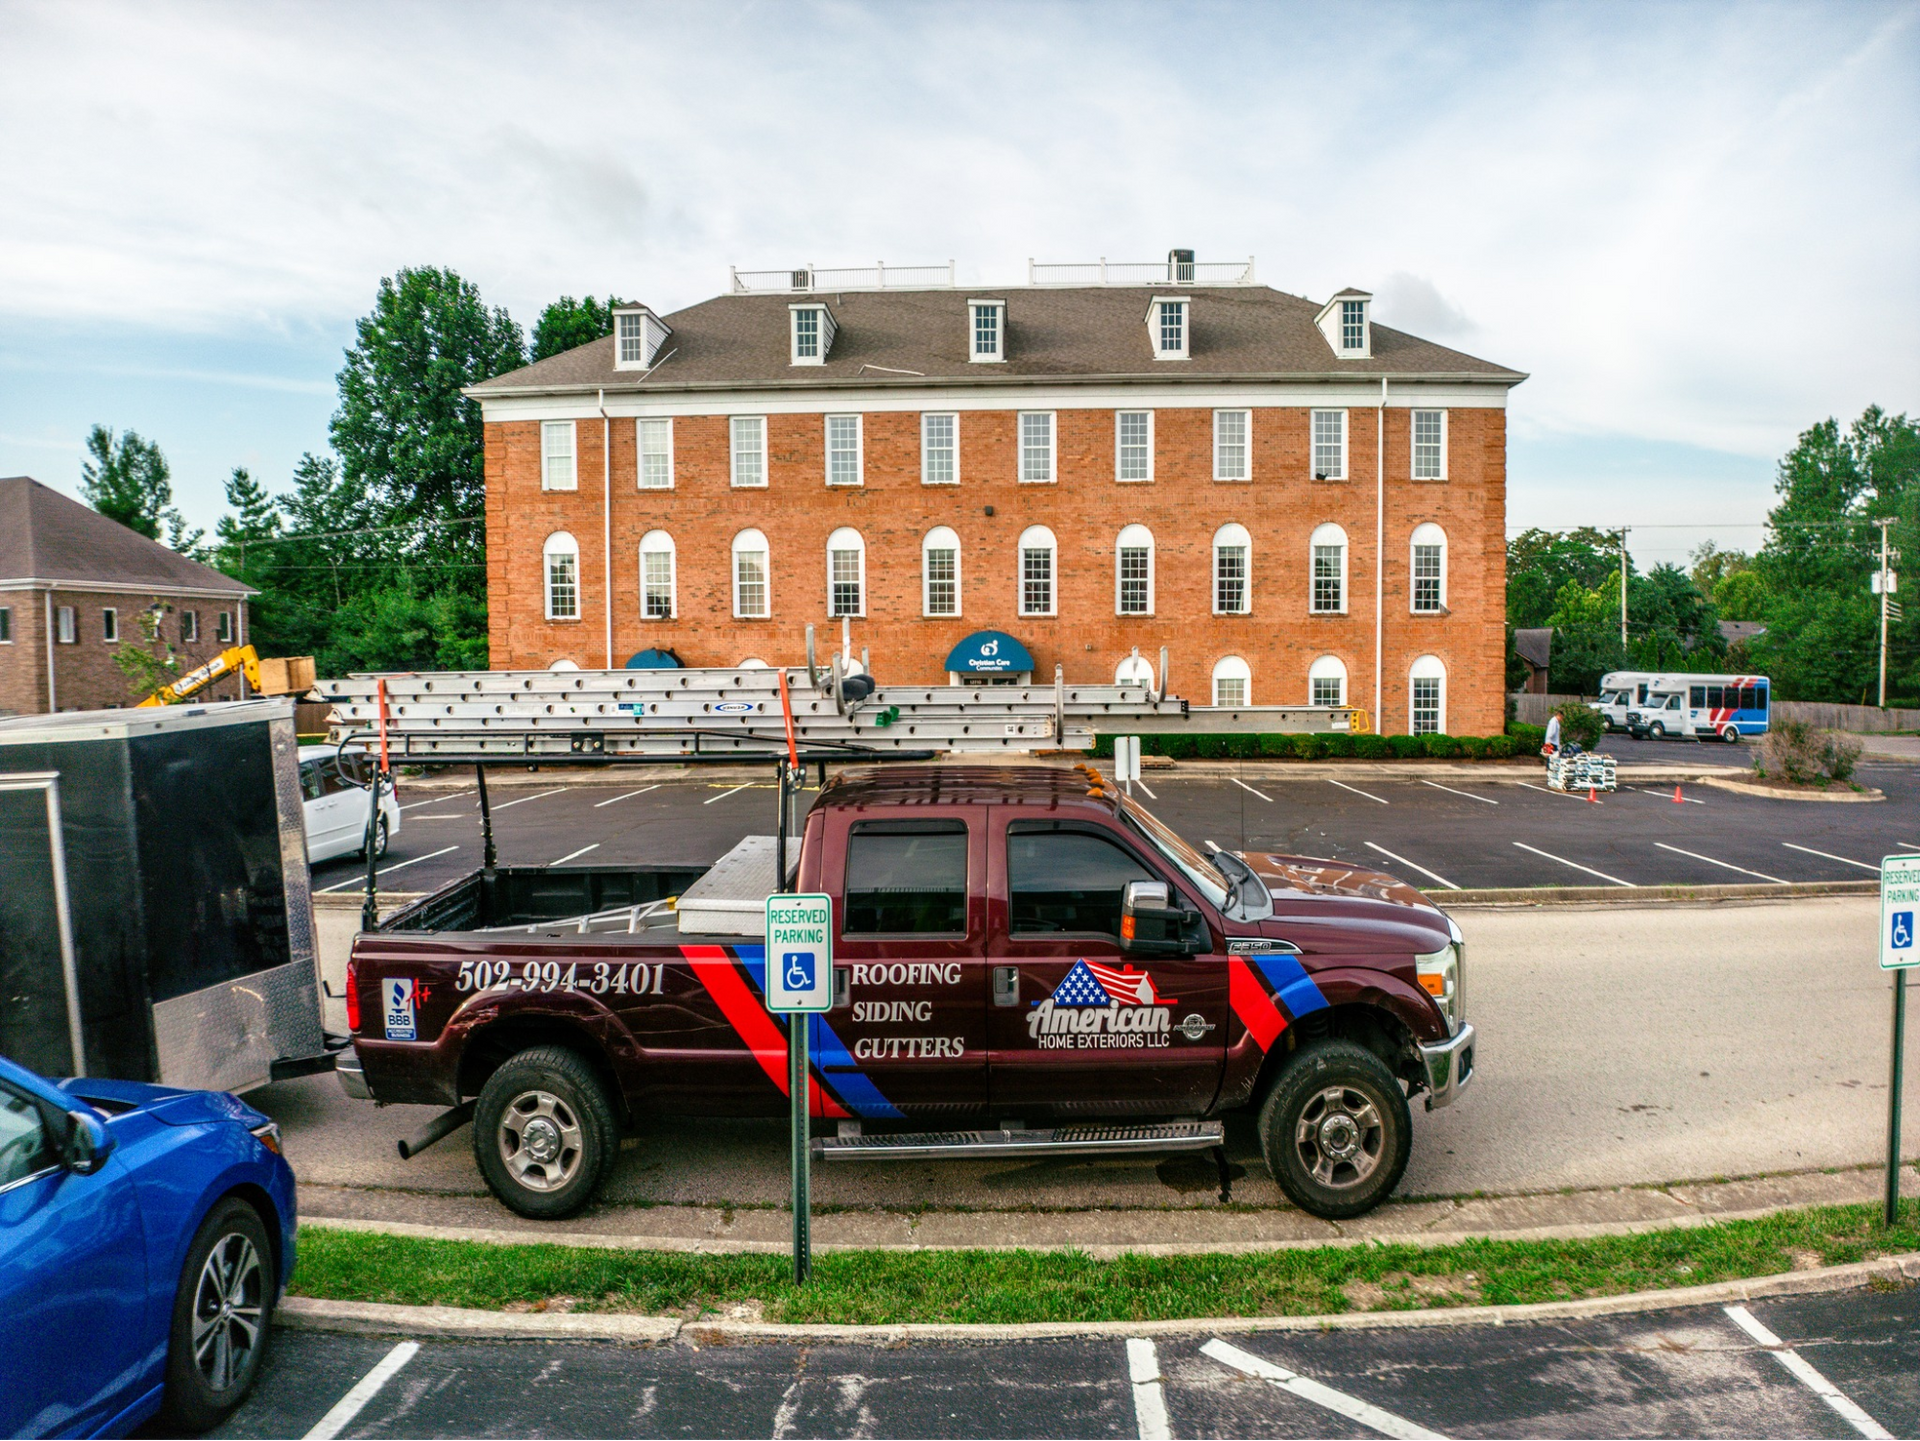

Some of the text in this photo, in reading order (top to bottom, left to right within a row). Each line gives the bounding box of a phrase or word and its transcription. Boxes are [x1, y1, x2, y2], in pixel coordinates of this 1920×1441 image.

[1887, 888, 1920, 903] PARKING
[770, 909, 826, 924] RESERVED
[774, 929, 823, 943] PARKING
[454, 960, 664, 995] 502-994-3401
[851, 963, 962, 985] ROOFING
[388, 1014, 411, 1026] BBB
[852, 1001, 933, 1022] SIDING
[1026, 998, 1171, 1038] American
[854, 1037, 965, 1059] GUTTERS
[1038, 1033, 1170, 1049] HOME EXTERIORS LLC
